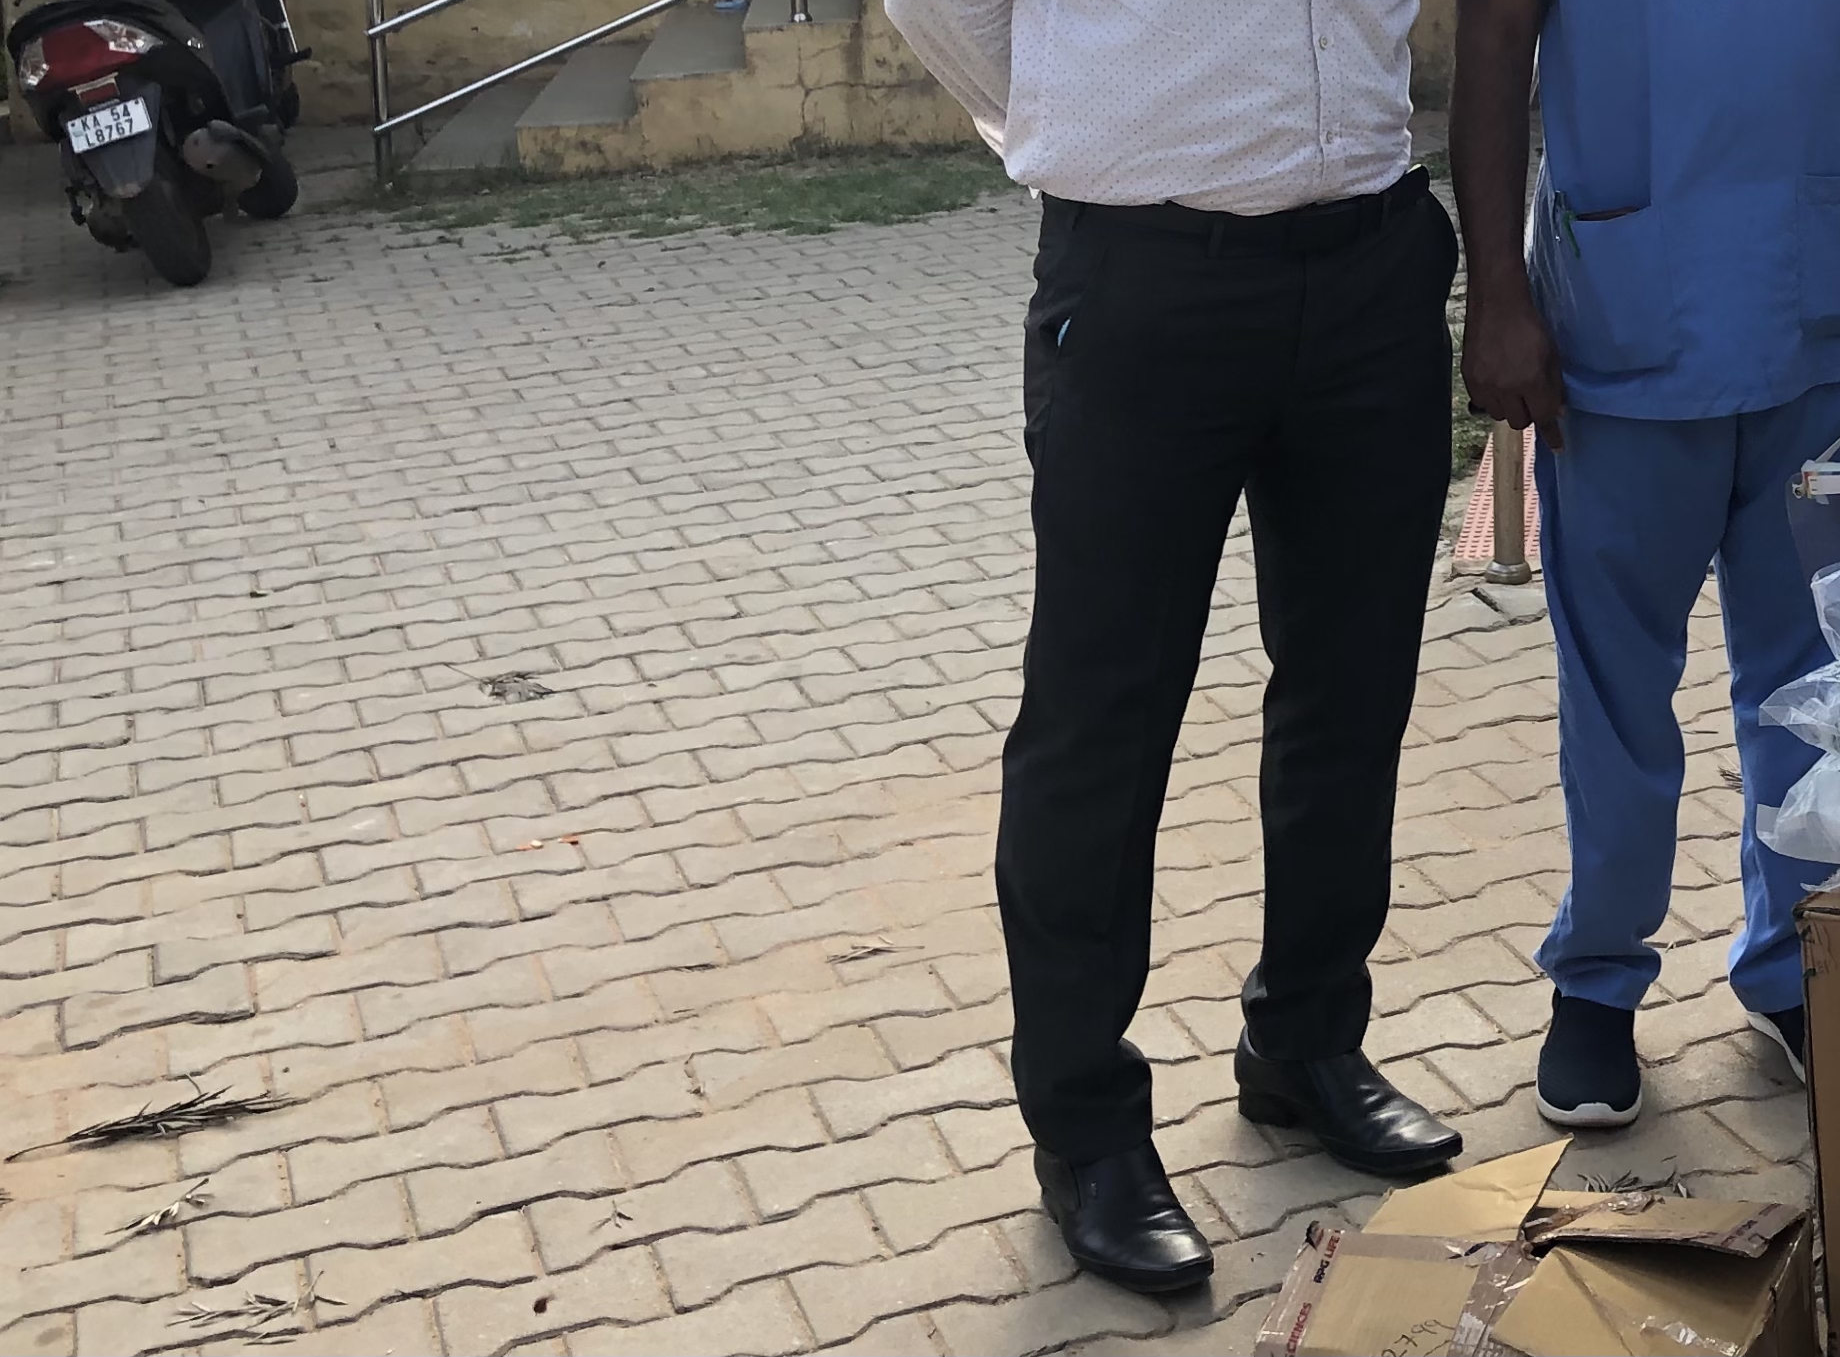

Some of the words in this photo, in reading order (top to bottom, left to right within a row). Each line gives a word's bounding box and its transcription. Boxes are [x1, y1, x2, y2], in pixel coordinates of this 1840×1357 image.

[81, 115, 101, 131] KA
[110, 104, 131, 121] 54
[86, 118, 134, 147] L8767
